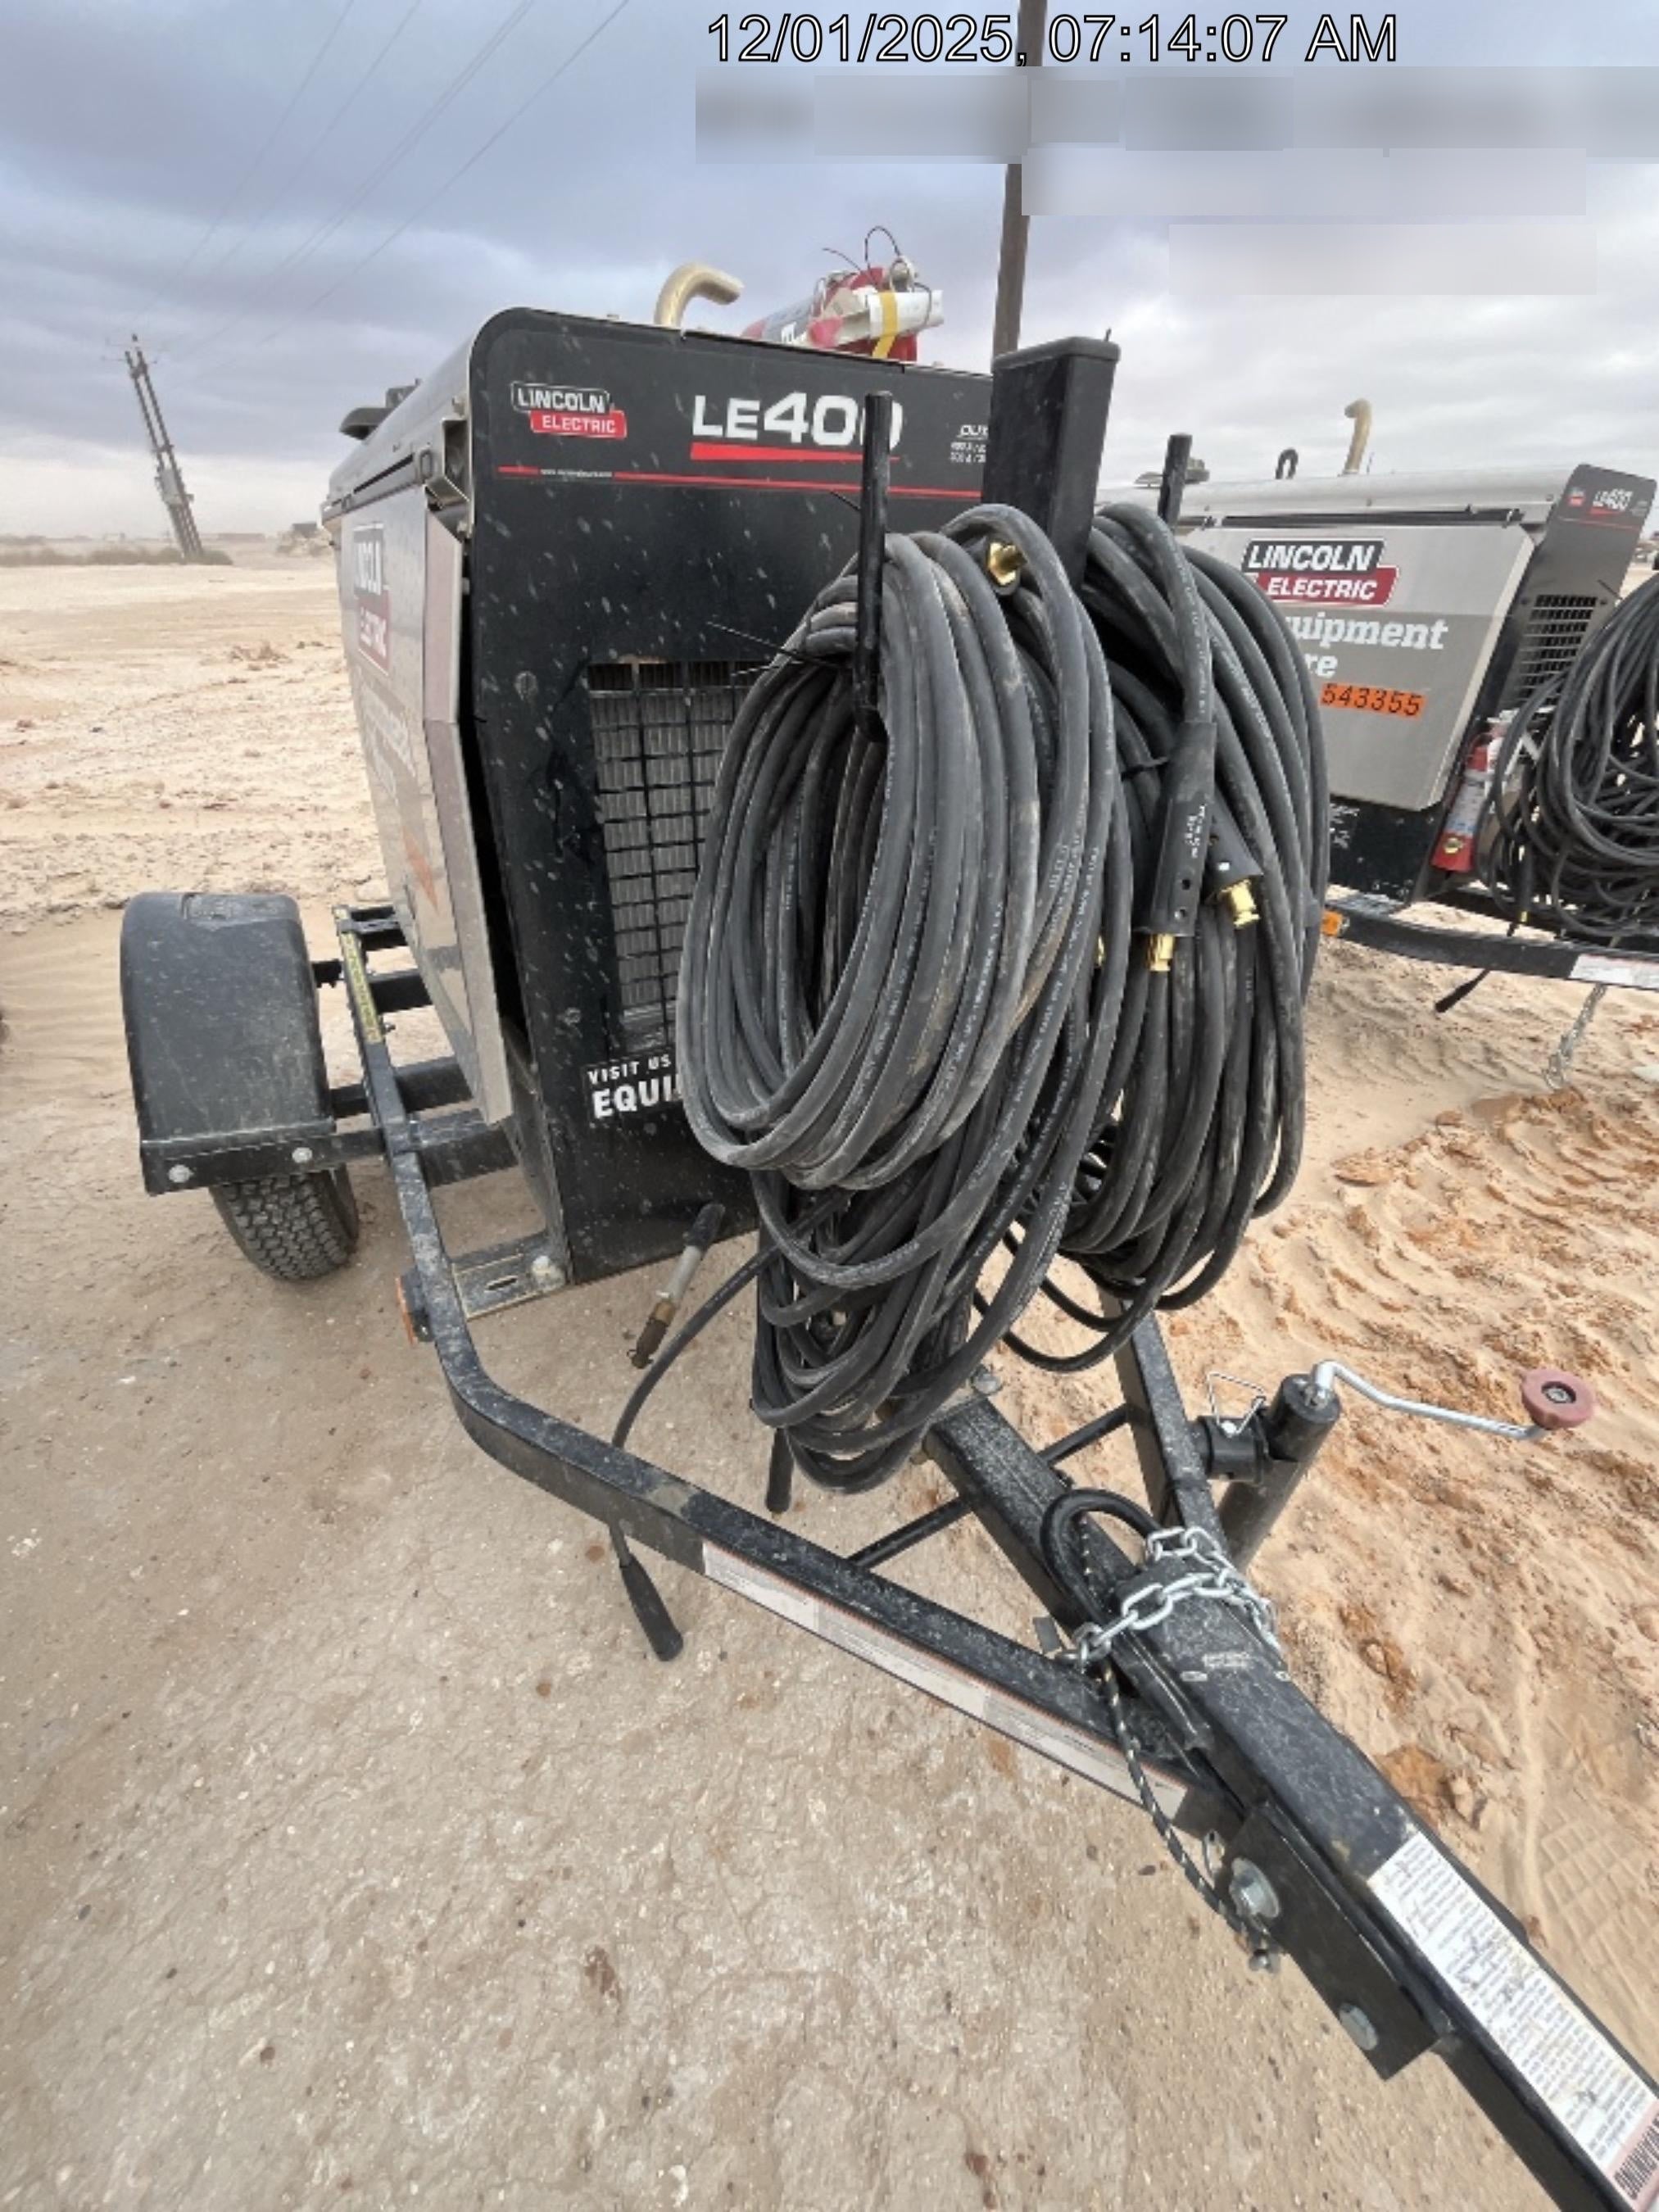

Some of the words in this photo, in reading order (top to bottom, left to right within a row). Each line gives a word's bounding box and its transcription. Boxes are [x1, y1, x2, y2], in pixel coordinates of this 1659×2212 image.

[517, 387, 606, 414] LINCOLN
[542, 414, 616, 433] ELECTRIC
[1247, 545, 1375, 571] LINCOLN
[1266, 577, 1377, 600] ELECTRIC
[1285, 612, 1448, 649] uipment
[1304, 653, 1338, 678] re
[1321, 682, 1422, 716] 543355
[587, 1061, 639, 1086] VISIT
[648, 1054, 671, 1070] US
[592, 1074, 682, 1119] EQUI
